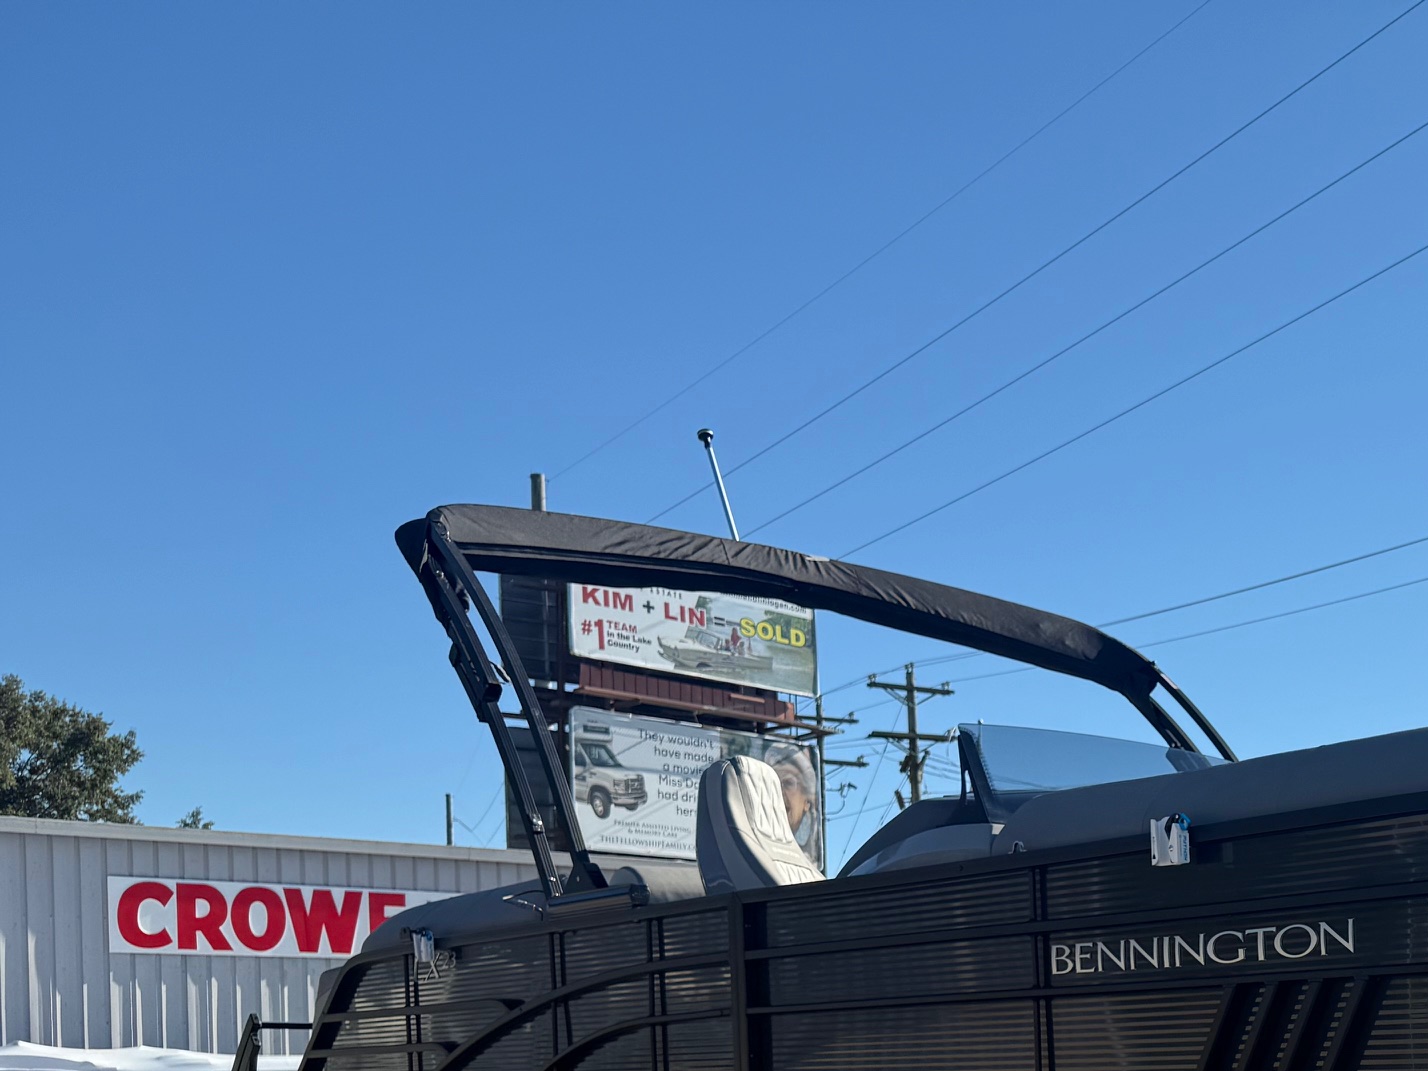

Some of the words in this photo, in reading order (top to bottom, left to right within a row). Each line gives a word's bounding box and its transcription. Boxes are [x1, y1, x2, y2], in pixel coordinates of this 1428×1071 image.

[581, 585, 634, 612] KIM
[642, 600, 655, 614] +
[664, 602, 706, 627] LIN
[739, 616, 807, 648] SOLD
[581, 619, 605, 651] #1
[606, 620, 638, 634] TEAM
[617, 632, 631, 641] the
[633, 635, 652, 645] Lake
[607, 639, 640, 653] Country
[639, 729, 664, 745] They
[668, 734, 714, 749] wouldn't
[654, 745, 680, 759] have
[684, 751, 714, 763] made
[663, 763, 669, 772] a
[659, 774, 682, 788] Miss
[658, 788, 678, 801] had
[676, 805, 698, 817] her
[1051, 917, 1355, 975] BENNINGTON
